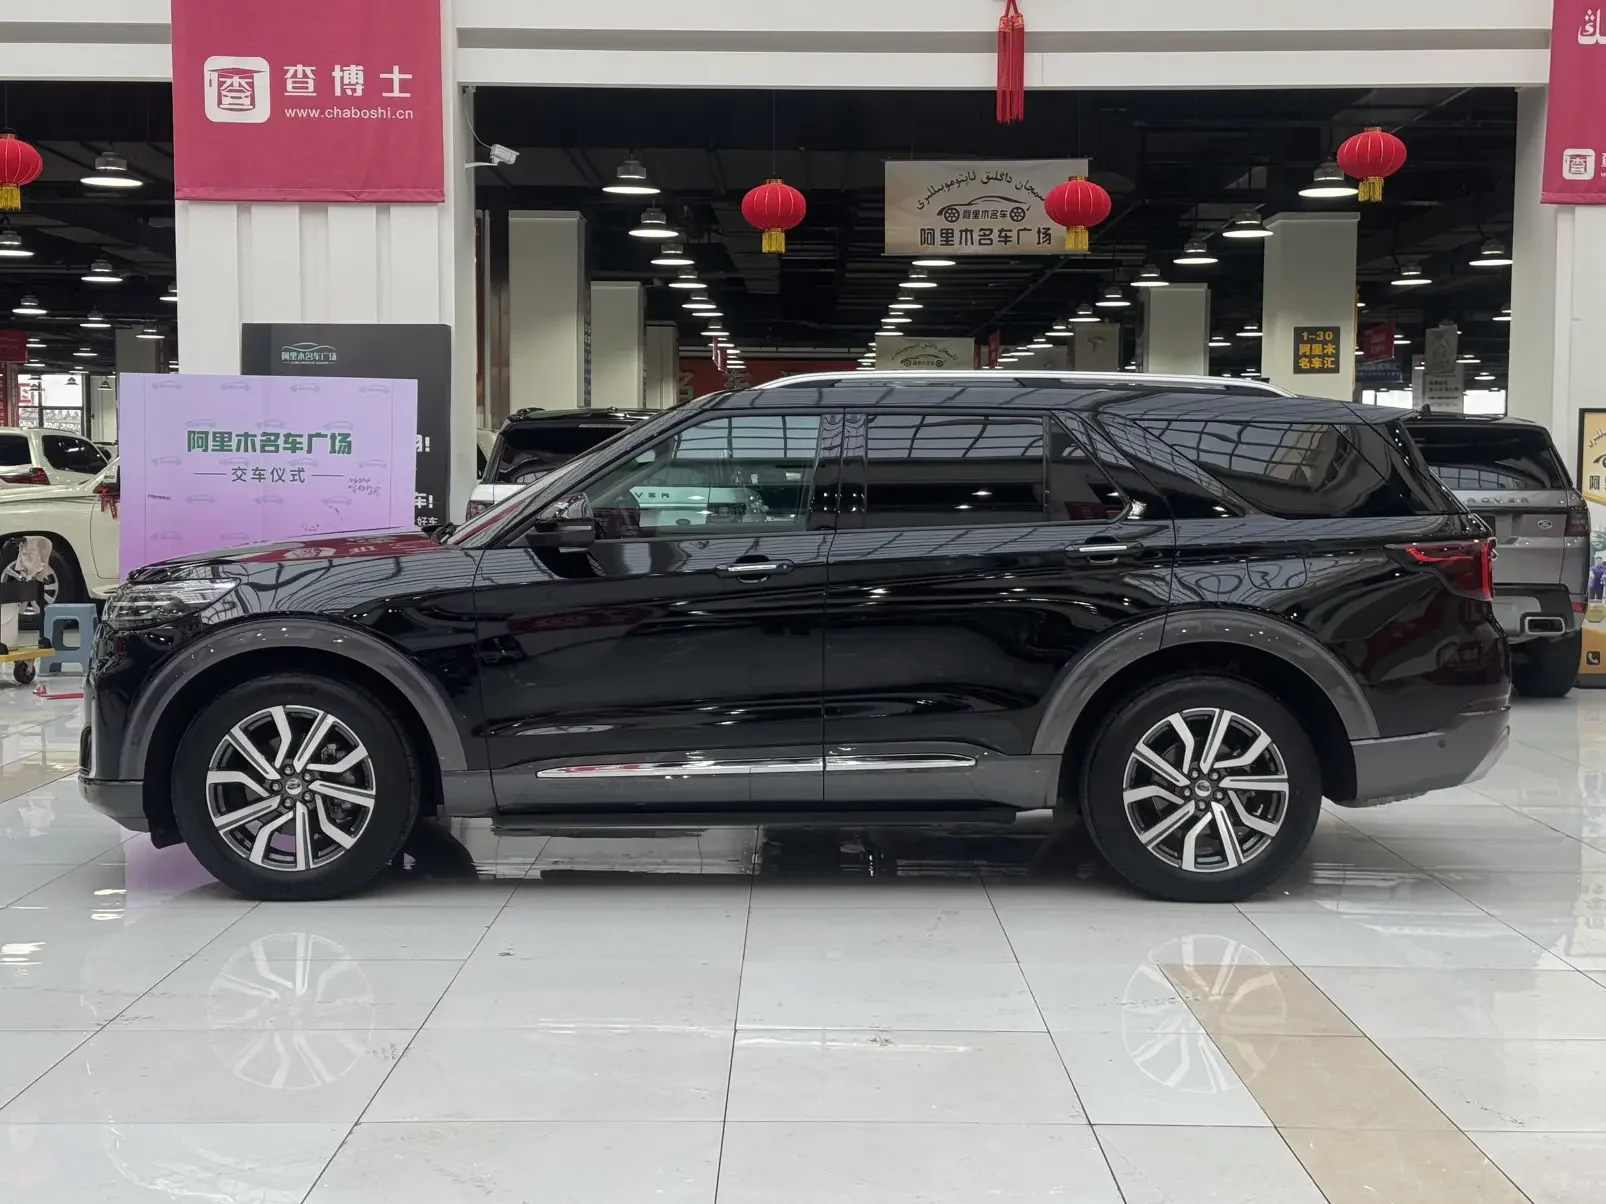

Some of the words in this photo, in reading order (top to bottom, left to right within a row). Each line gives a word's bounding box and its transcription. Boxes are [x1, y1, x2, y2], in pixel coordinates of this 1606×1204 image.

[283, 64, 413, 98] 查博士
[284, 106, 414, 119] www.chaboshi.cn
[962, 209, 1009, 220] 阿里木名车
[920, 227, 1052, 247] 阿里木名车广场
[1299, 343, 1336, 355] 阿里木
[1298, 357, 1336, 369] 名车汇
[187, 430, 352, 455] 阿里木名车广场
[231, 467, 306, 483] 交车仪式
